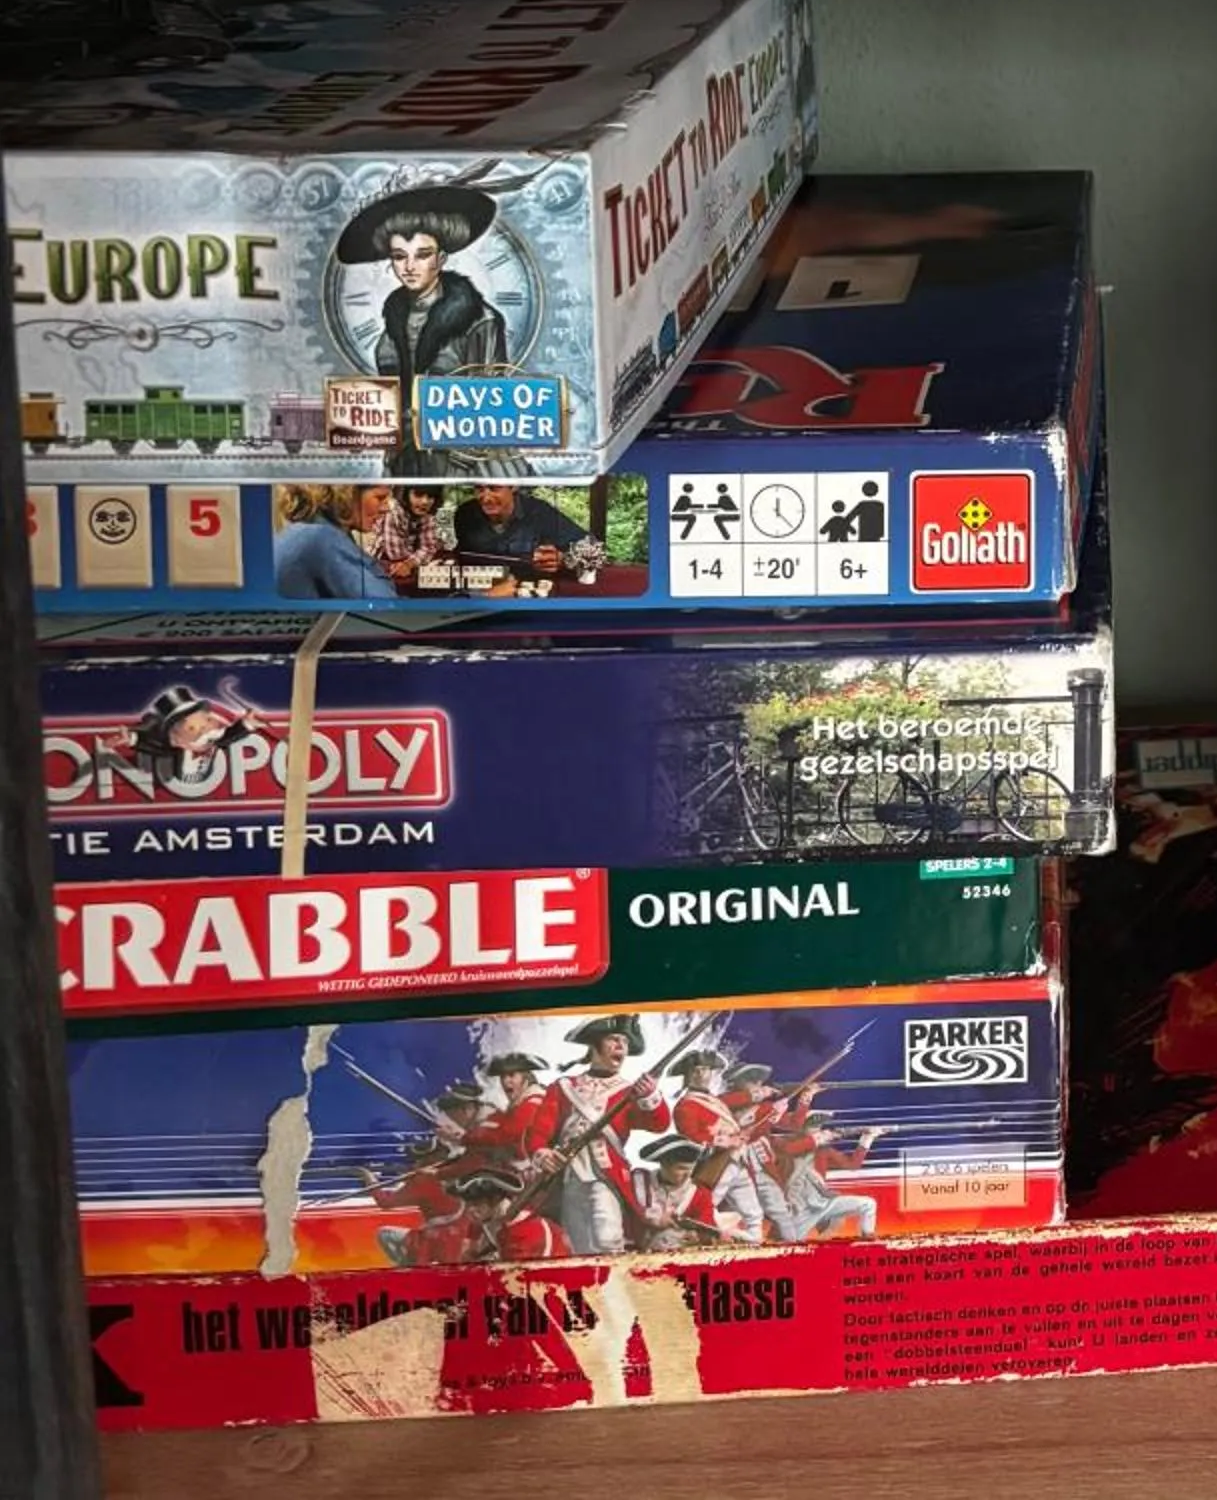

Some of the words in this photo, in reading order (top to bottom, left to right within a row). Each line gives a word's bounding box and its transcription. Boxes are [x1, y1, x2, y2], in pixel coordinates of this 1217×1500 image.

[604, 129, 689, 298] TICKET
[705, 62, 751, 169] RIDE
[9, 229, 280, 304] EUROPE
[332, 388, 383, 405] TICKET
[427, 383, 504, 411] DAYS
[513, 383, 553, 409] OF
[351, 406, 397, 428] RIDE
[427, 413, 555, 441] WONDER
[187, 499, 222, 538] 5
[921, 523, 1026, 566] Goliath
[688, 558, 724, 580] 1-4
[840, 557, 869, 580] 6+
[813, 716, 868, 740] Het
[878, 713, 1043, 738] beroemde
[43, 726, 430, 801] ONOPOLY
[800, 748, 1062, 782] gezelschapsspel
[628, 881, 859, 928] ORIGINAL
[962, 884, 1011, 898] 52346
[56, 876, 577, 992] RABBLE
[318, 978, 365, 992] WETTIG
[909, 1020, 1024, 1048] PARKER
[921, 1180, 960, 1195] Vanaf
[966, 1181, 980, 1193] 10
[985, 1180, 1009, 1194] jaar
[1116, 1239, 1135, 1252] de
[1141, 1238, 1175, 1253] loop
[181, 1301, 241, 1354] het
[844, 1312, 883, 1326] Door
[958, 1305, 1016, 1319] denken
